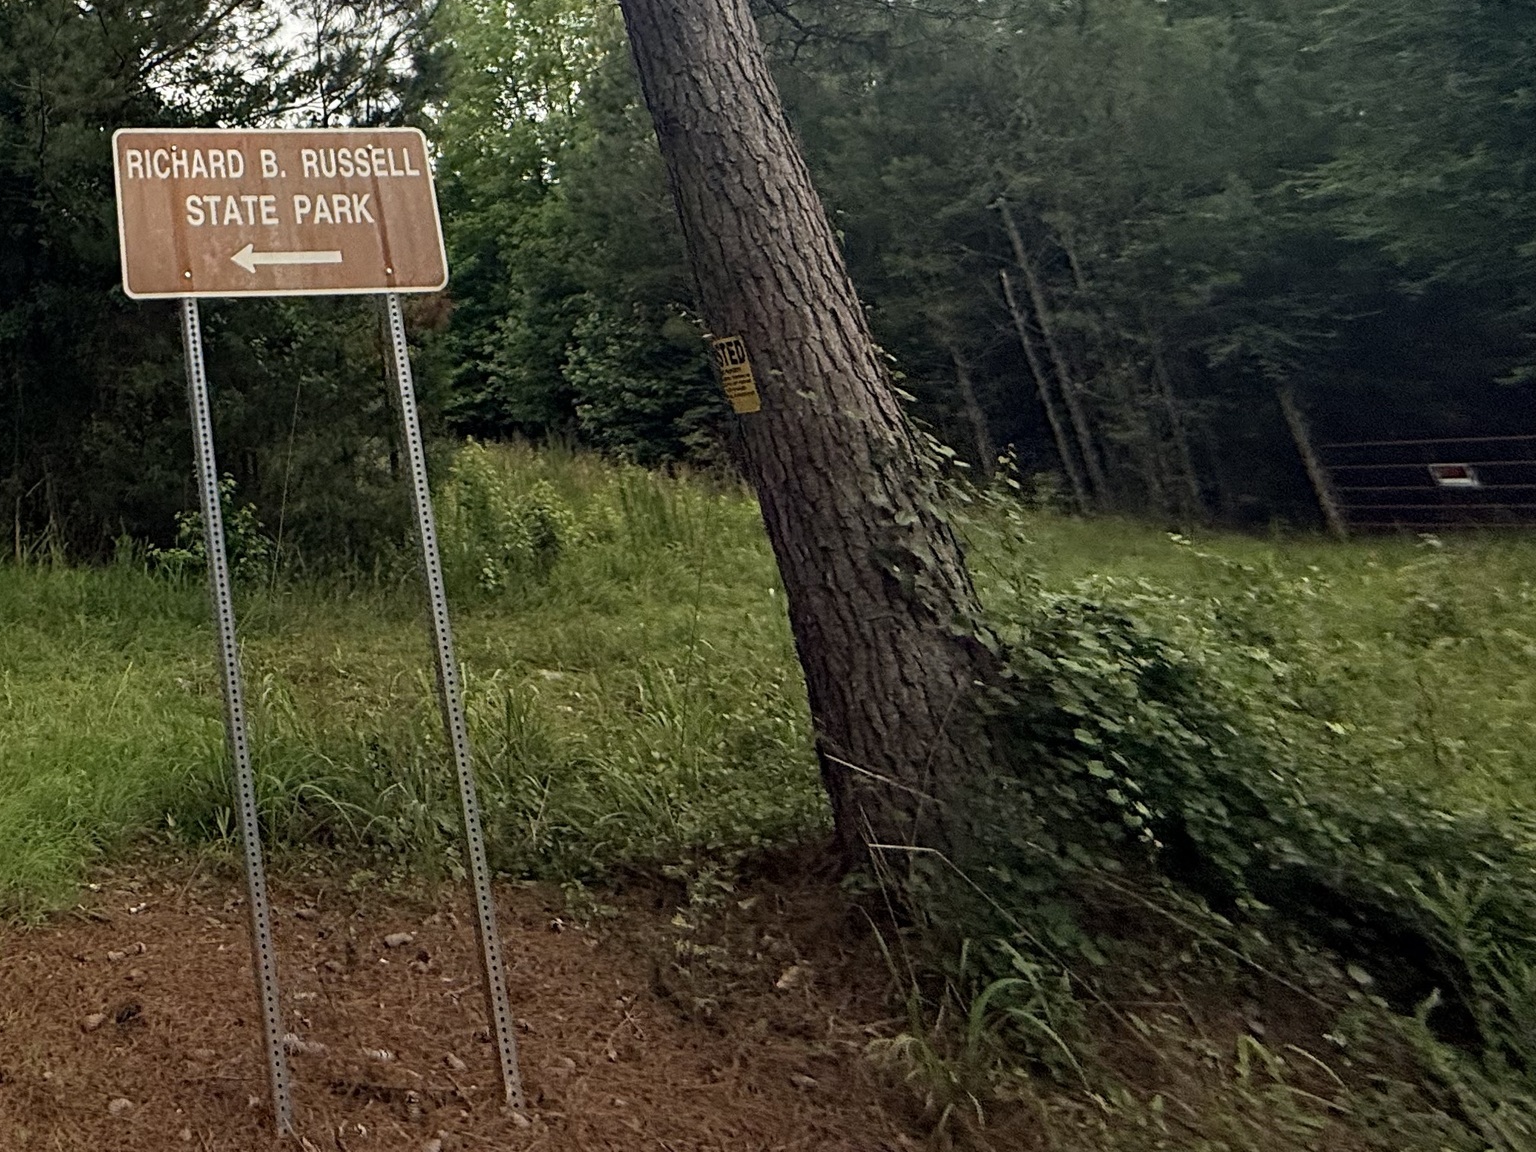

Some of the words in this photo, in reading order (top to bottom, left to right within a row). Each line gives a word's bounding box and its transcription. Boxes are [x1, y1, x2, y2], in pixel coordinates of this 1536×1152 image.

[126, 149, 245, 179] RICHARD
[261, 149, 287, 179] B.
[302, 147, 421, 179] RUSSELL
[186, 195, 280, 227] STATE
[294, 193, 375, 225] PARK
